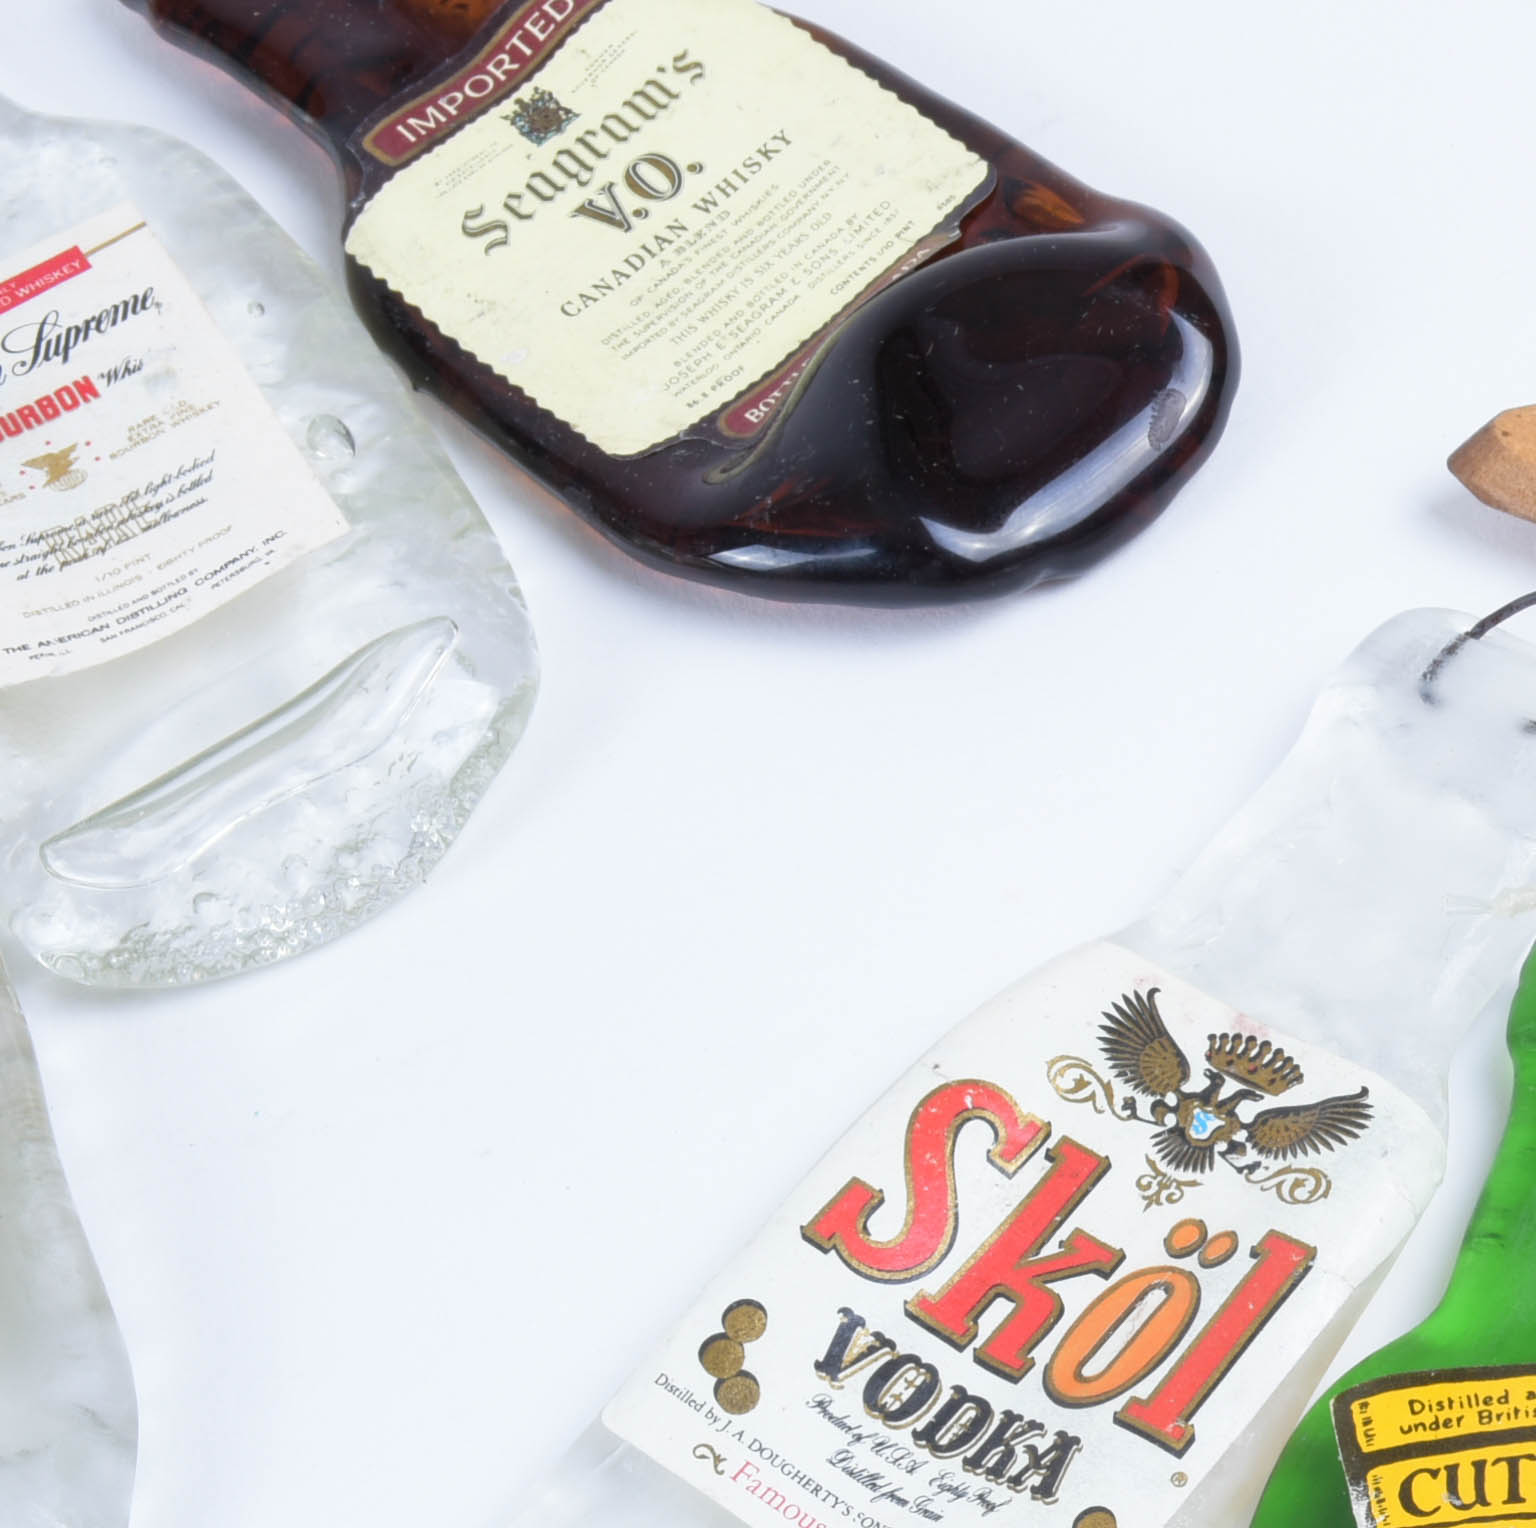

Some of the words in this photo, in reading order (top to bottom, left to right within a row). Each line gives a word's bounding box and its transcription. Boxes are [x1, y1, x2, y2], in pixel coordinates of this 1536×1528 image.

[396, 0, 580, 143] IMPORTED
[464, 43, 708, 260] Seagram's
[560, 217, 689, 318] CANADIAN
[691, 129, 792, 215] WHISKY
[13, 257, 83, 300] WHISKEY
[2, 287, 155, 376] Supreme
[0, 375, 101, 443] URBON
[799, 1079, 1317, 1459] Sköl
[653, 1372, 706, 1413] Distilled
[703, 1405, 722, 1426] by
[813, 1306, 1084, 1506] VODKA
[1399, 1414, 1465, 1435] under
[1407, 1388, 1510, 1416] Distilled
